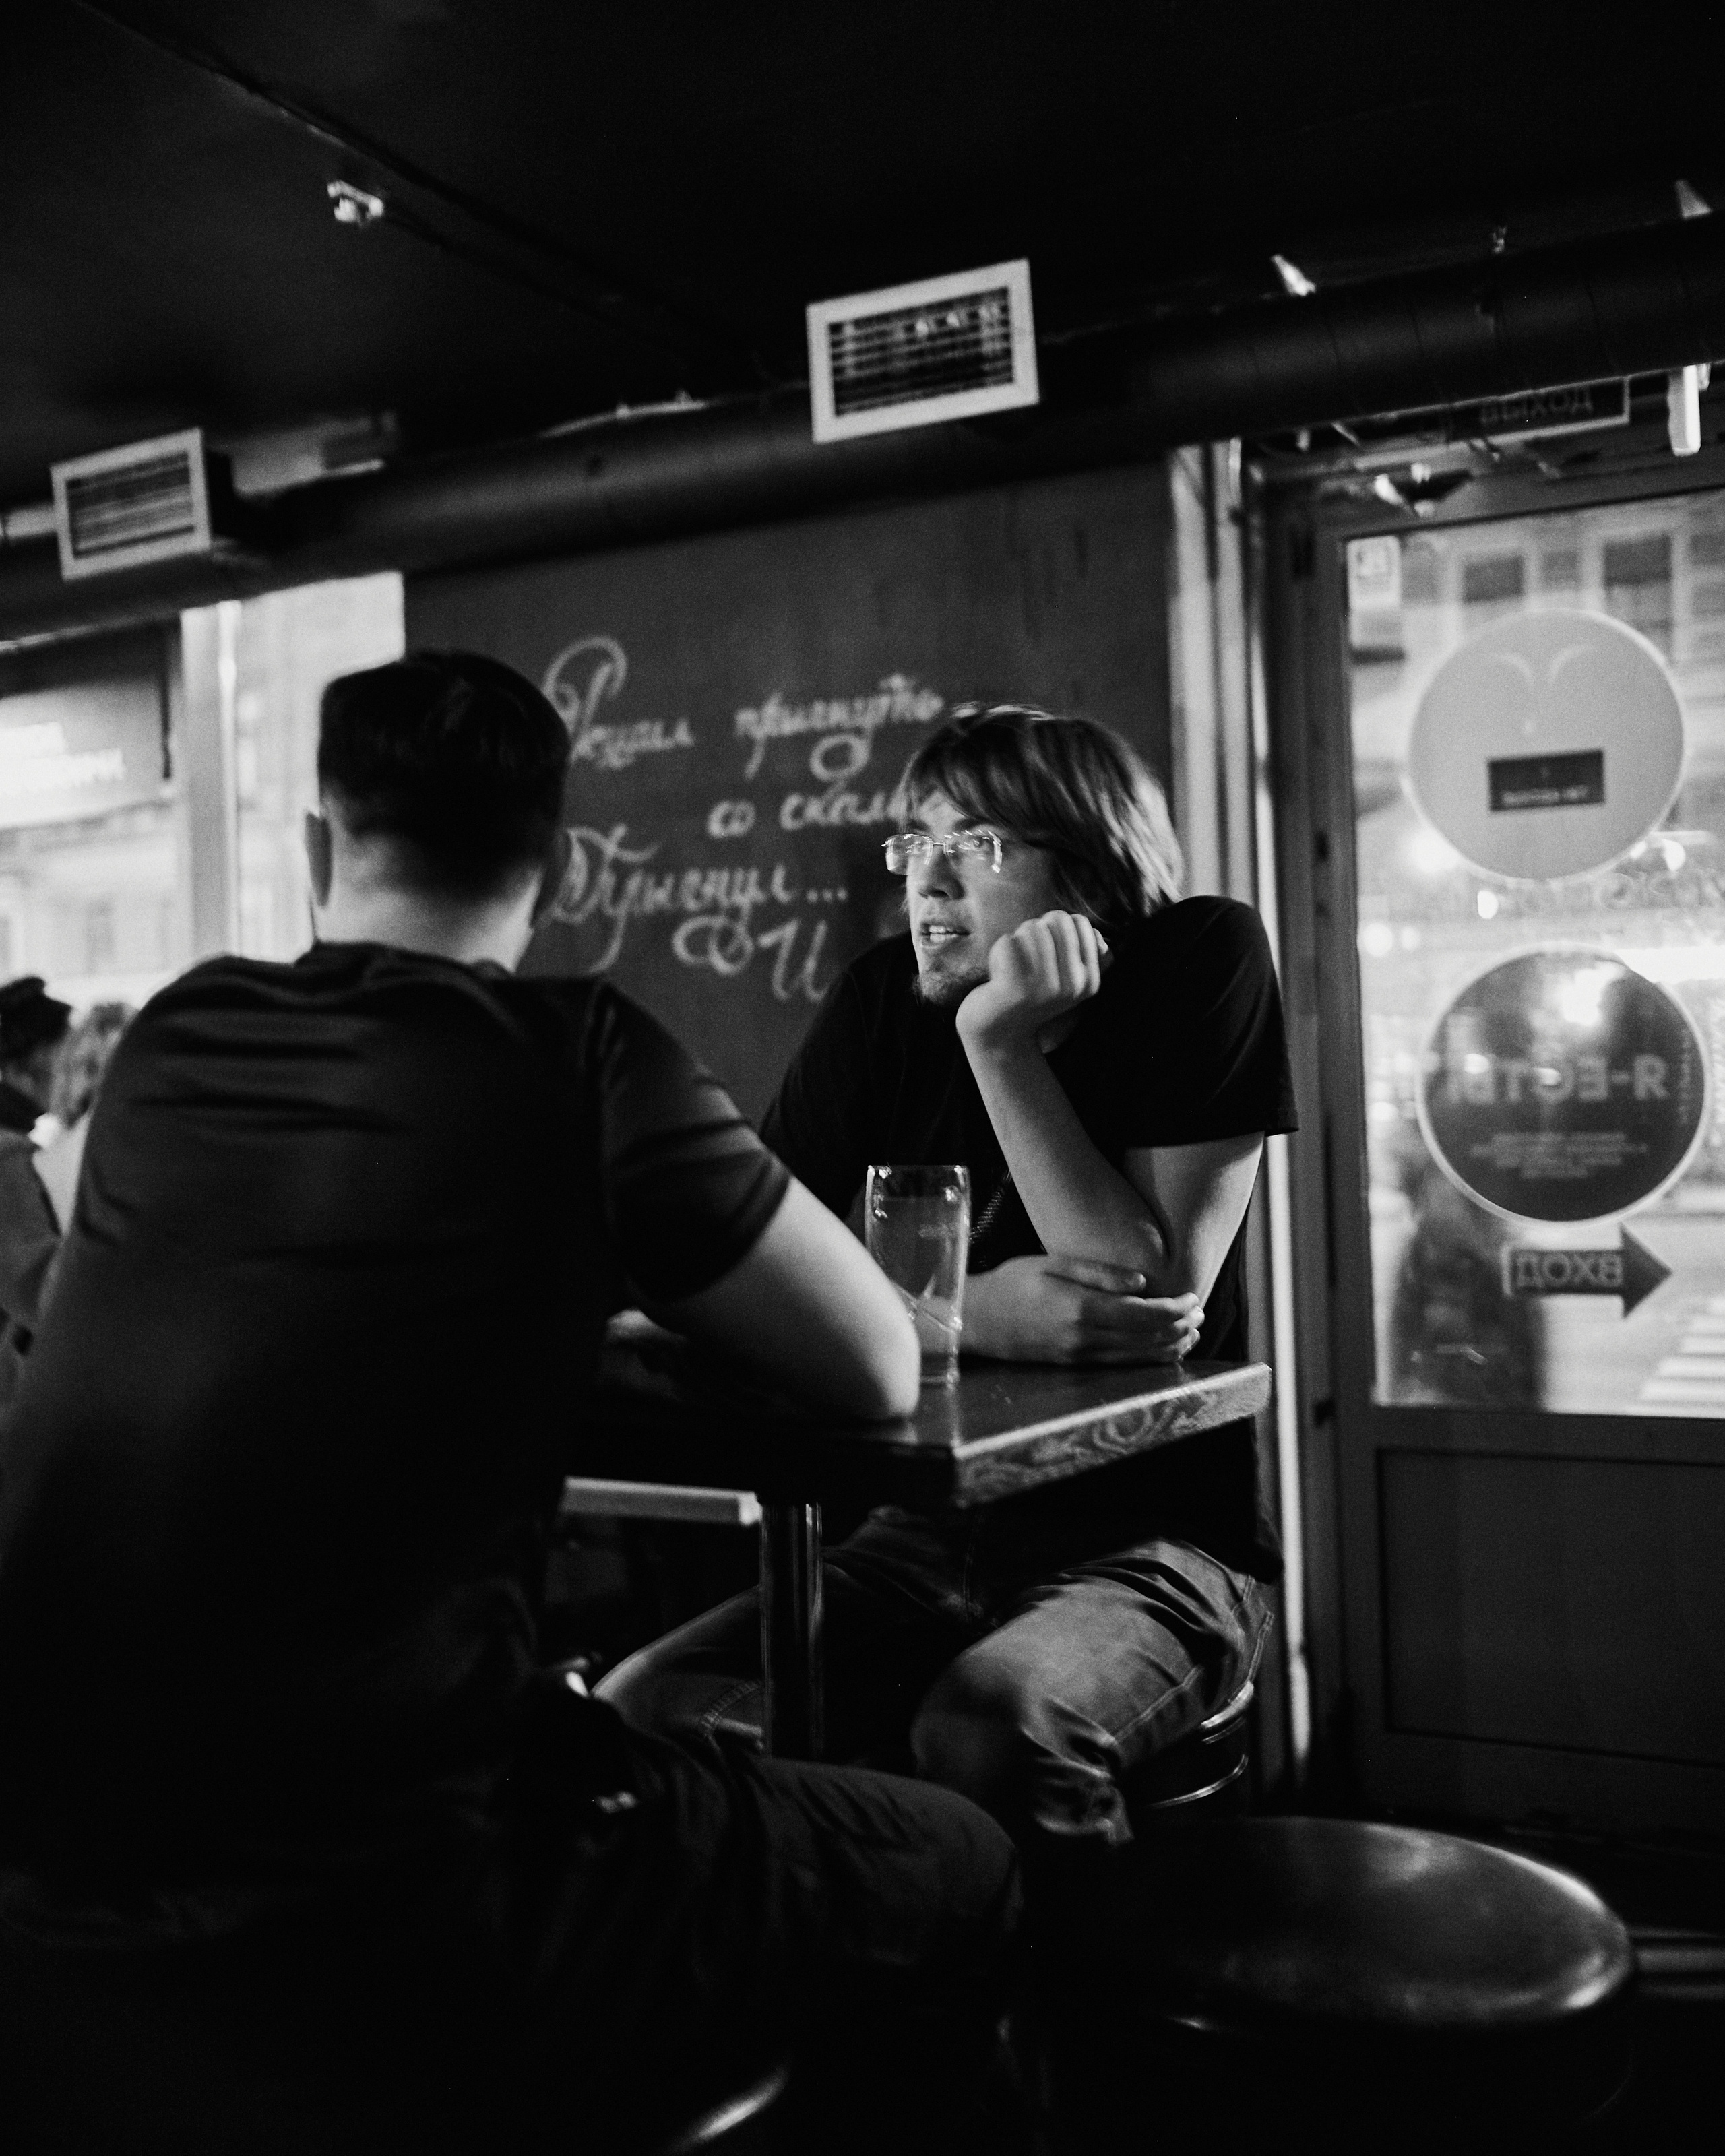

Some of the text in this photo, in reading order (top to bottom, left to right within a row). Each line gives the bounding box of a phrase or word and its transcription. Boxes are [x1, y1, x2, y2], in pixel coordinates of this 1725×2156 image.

[1480, 386, 1594, 425] ВЫХОД
[706, 783, 906, 840] со скал
